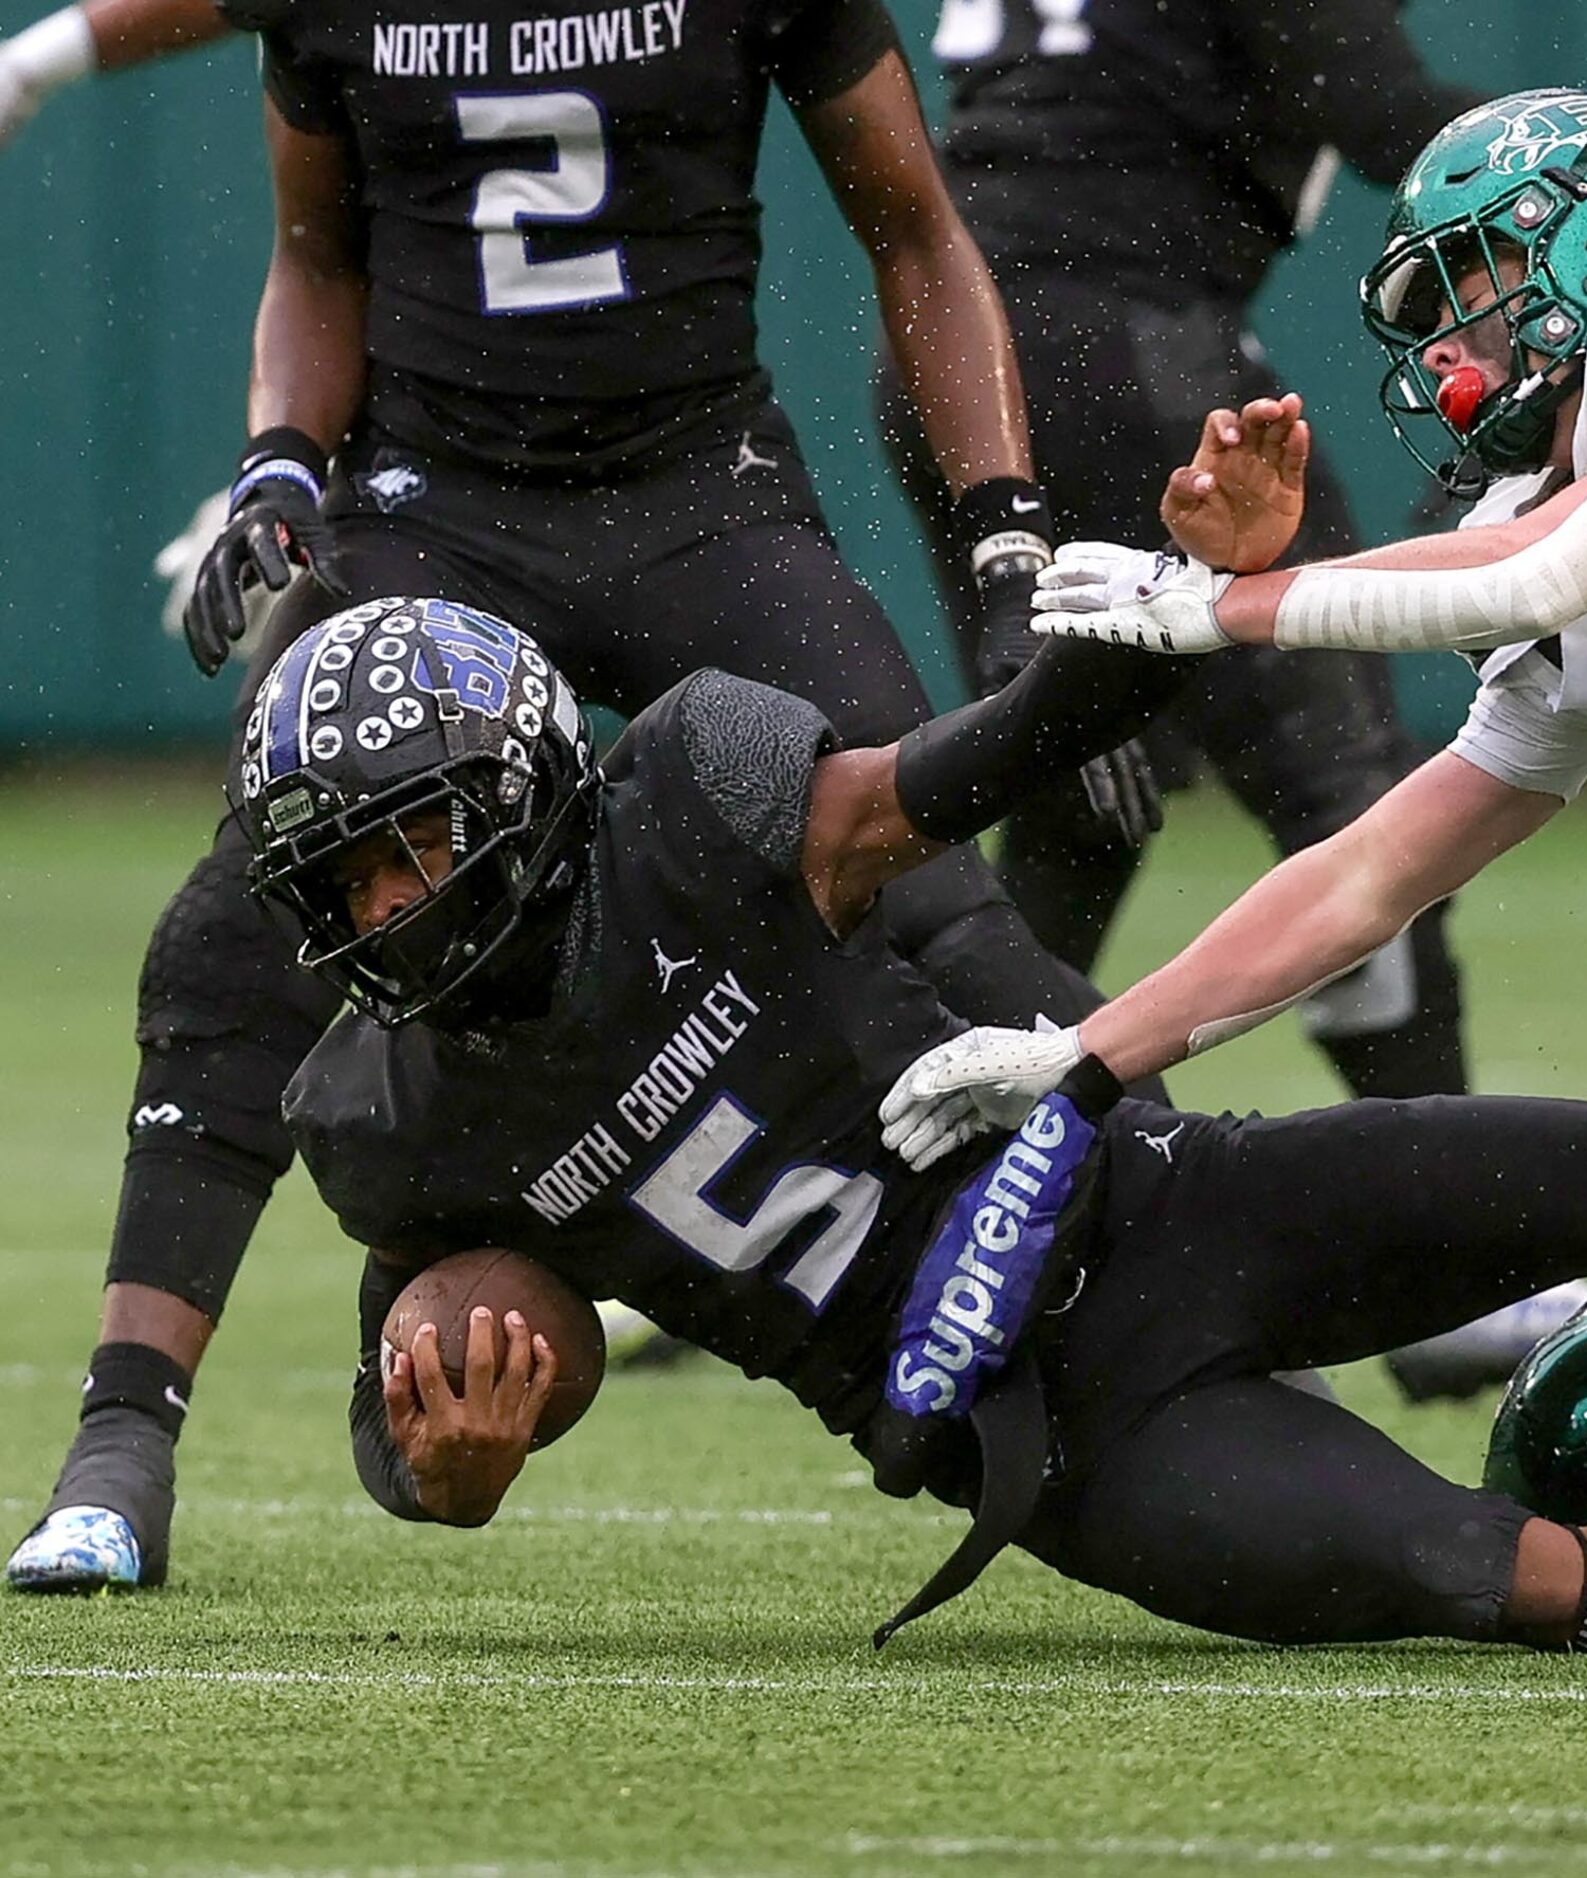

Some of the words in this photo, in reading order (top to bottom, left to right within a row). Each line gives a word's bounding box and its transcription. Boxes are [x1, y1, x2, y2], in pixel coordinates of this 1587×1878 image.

[373, 23, 488, 76] NORTH
[510, 0, 686, 75] CROWLEY
[453, 87, 633, 317] 2
[411, 598, 519, 719] 817
[451, 799, 468, 853] chutt
[521, 1122, 632, 1226] NORTH
[616, 969, 761, 1143] CROWLEY
[626, 1090, 884, 1315] 5
[896, 1102, 1066, 1412] Supreme
